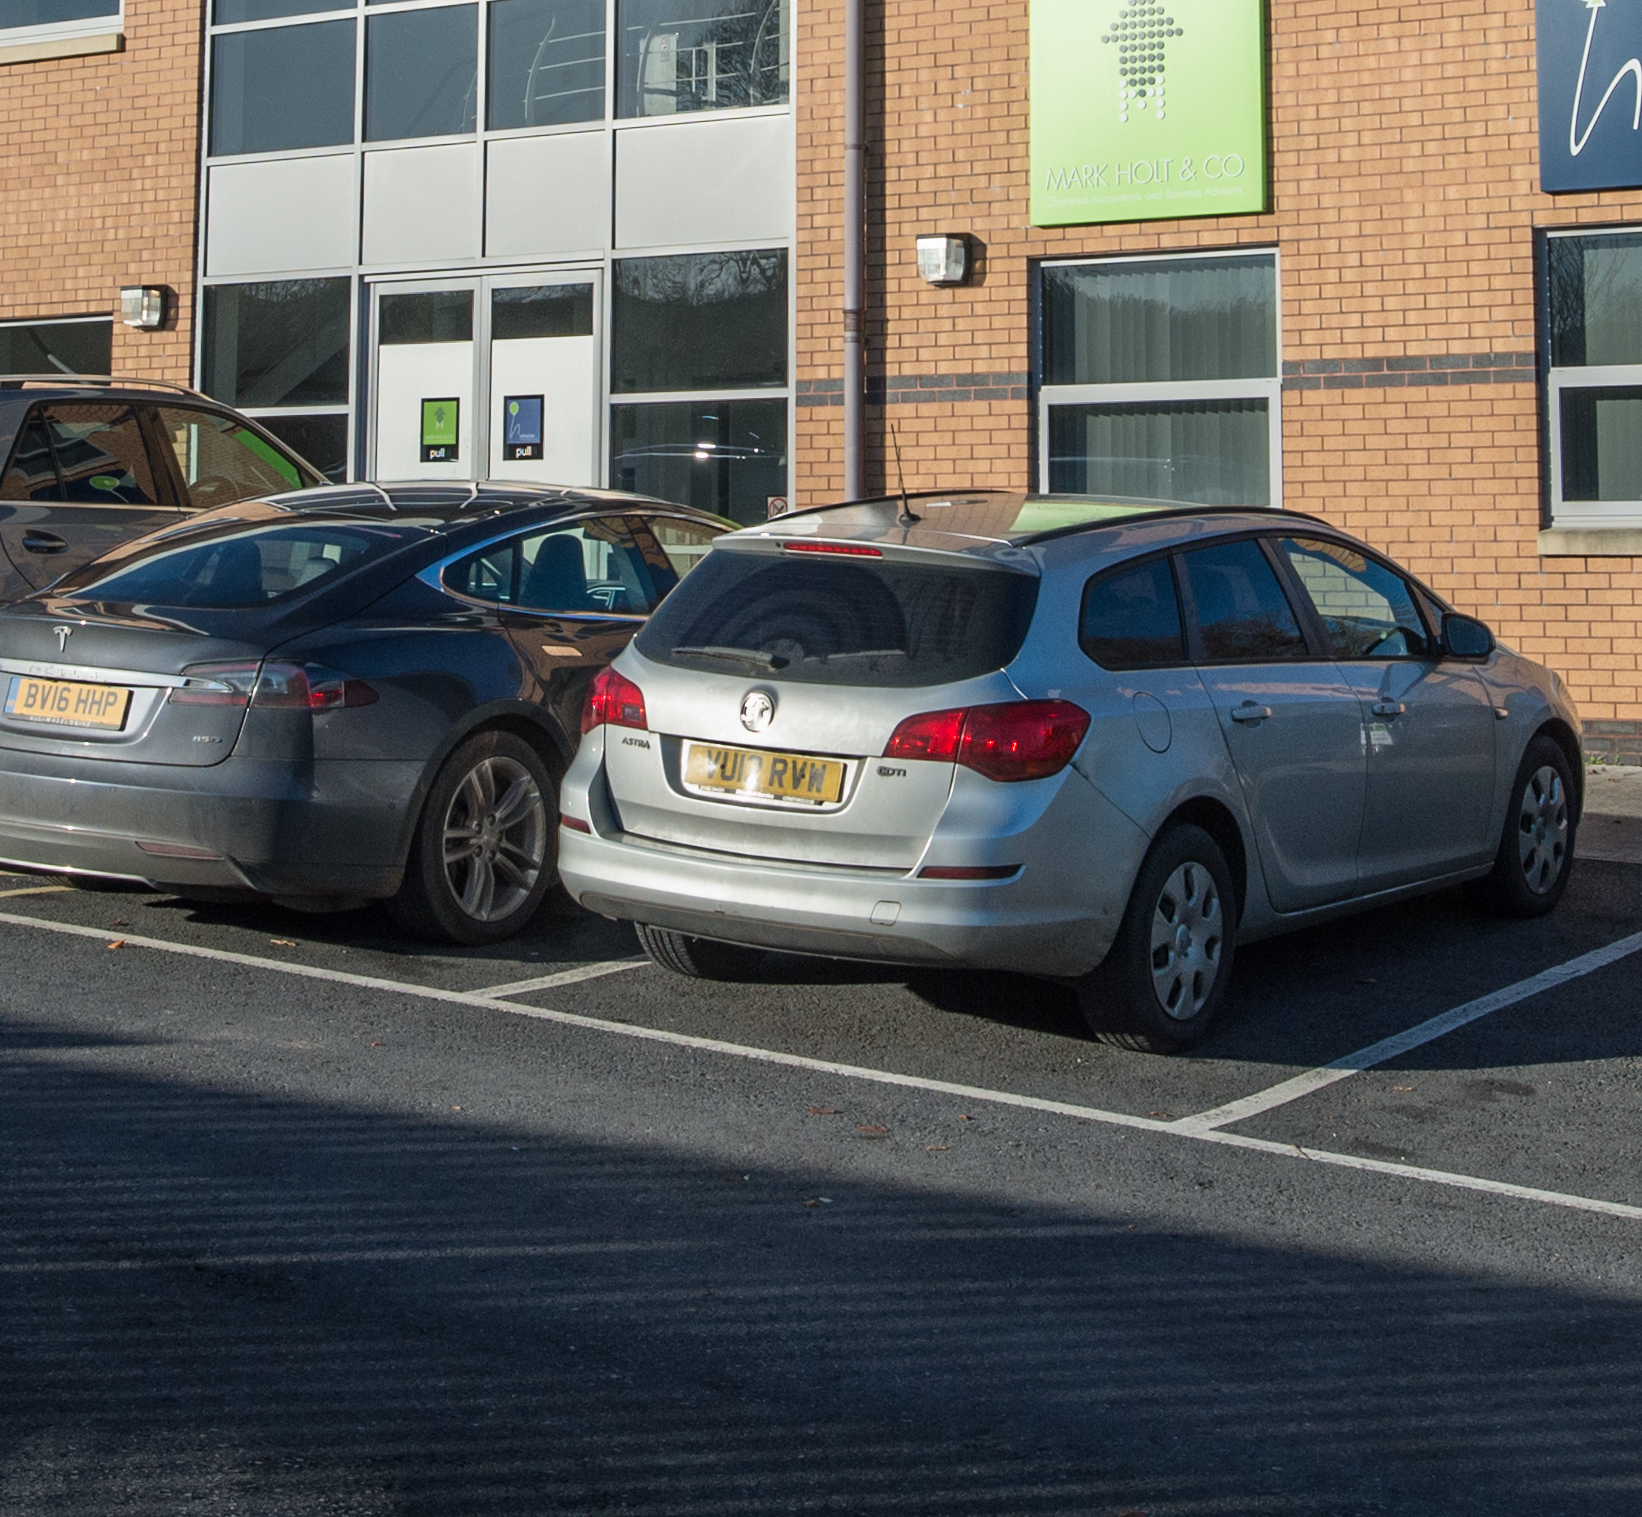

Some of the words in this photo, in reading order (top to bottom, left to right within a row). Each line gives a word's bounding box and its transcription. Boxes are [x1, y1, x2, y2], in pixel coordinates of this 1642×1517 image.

[1044, 163, 1109, 191] MARK
[1115, 158, 1174, 187] HOLT
[1179, 157, 1197, 182] &
[1203, 153, 1246, 180] CO
[1145, 189, 1163, 201] and
[1166, 187, 1202, 200] Business
[430, 447, 446, 460] pull
[515, 445, 532, 458] pull
[23, 683, 70, 712] BV16
[74, 688, 118, 717] HHP
[621, 736, 651, 750] ASTRA
[768, 757, 827, 793] RVW
